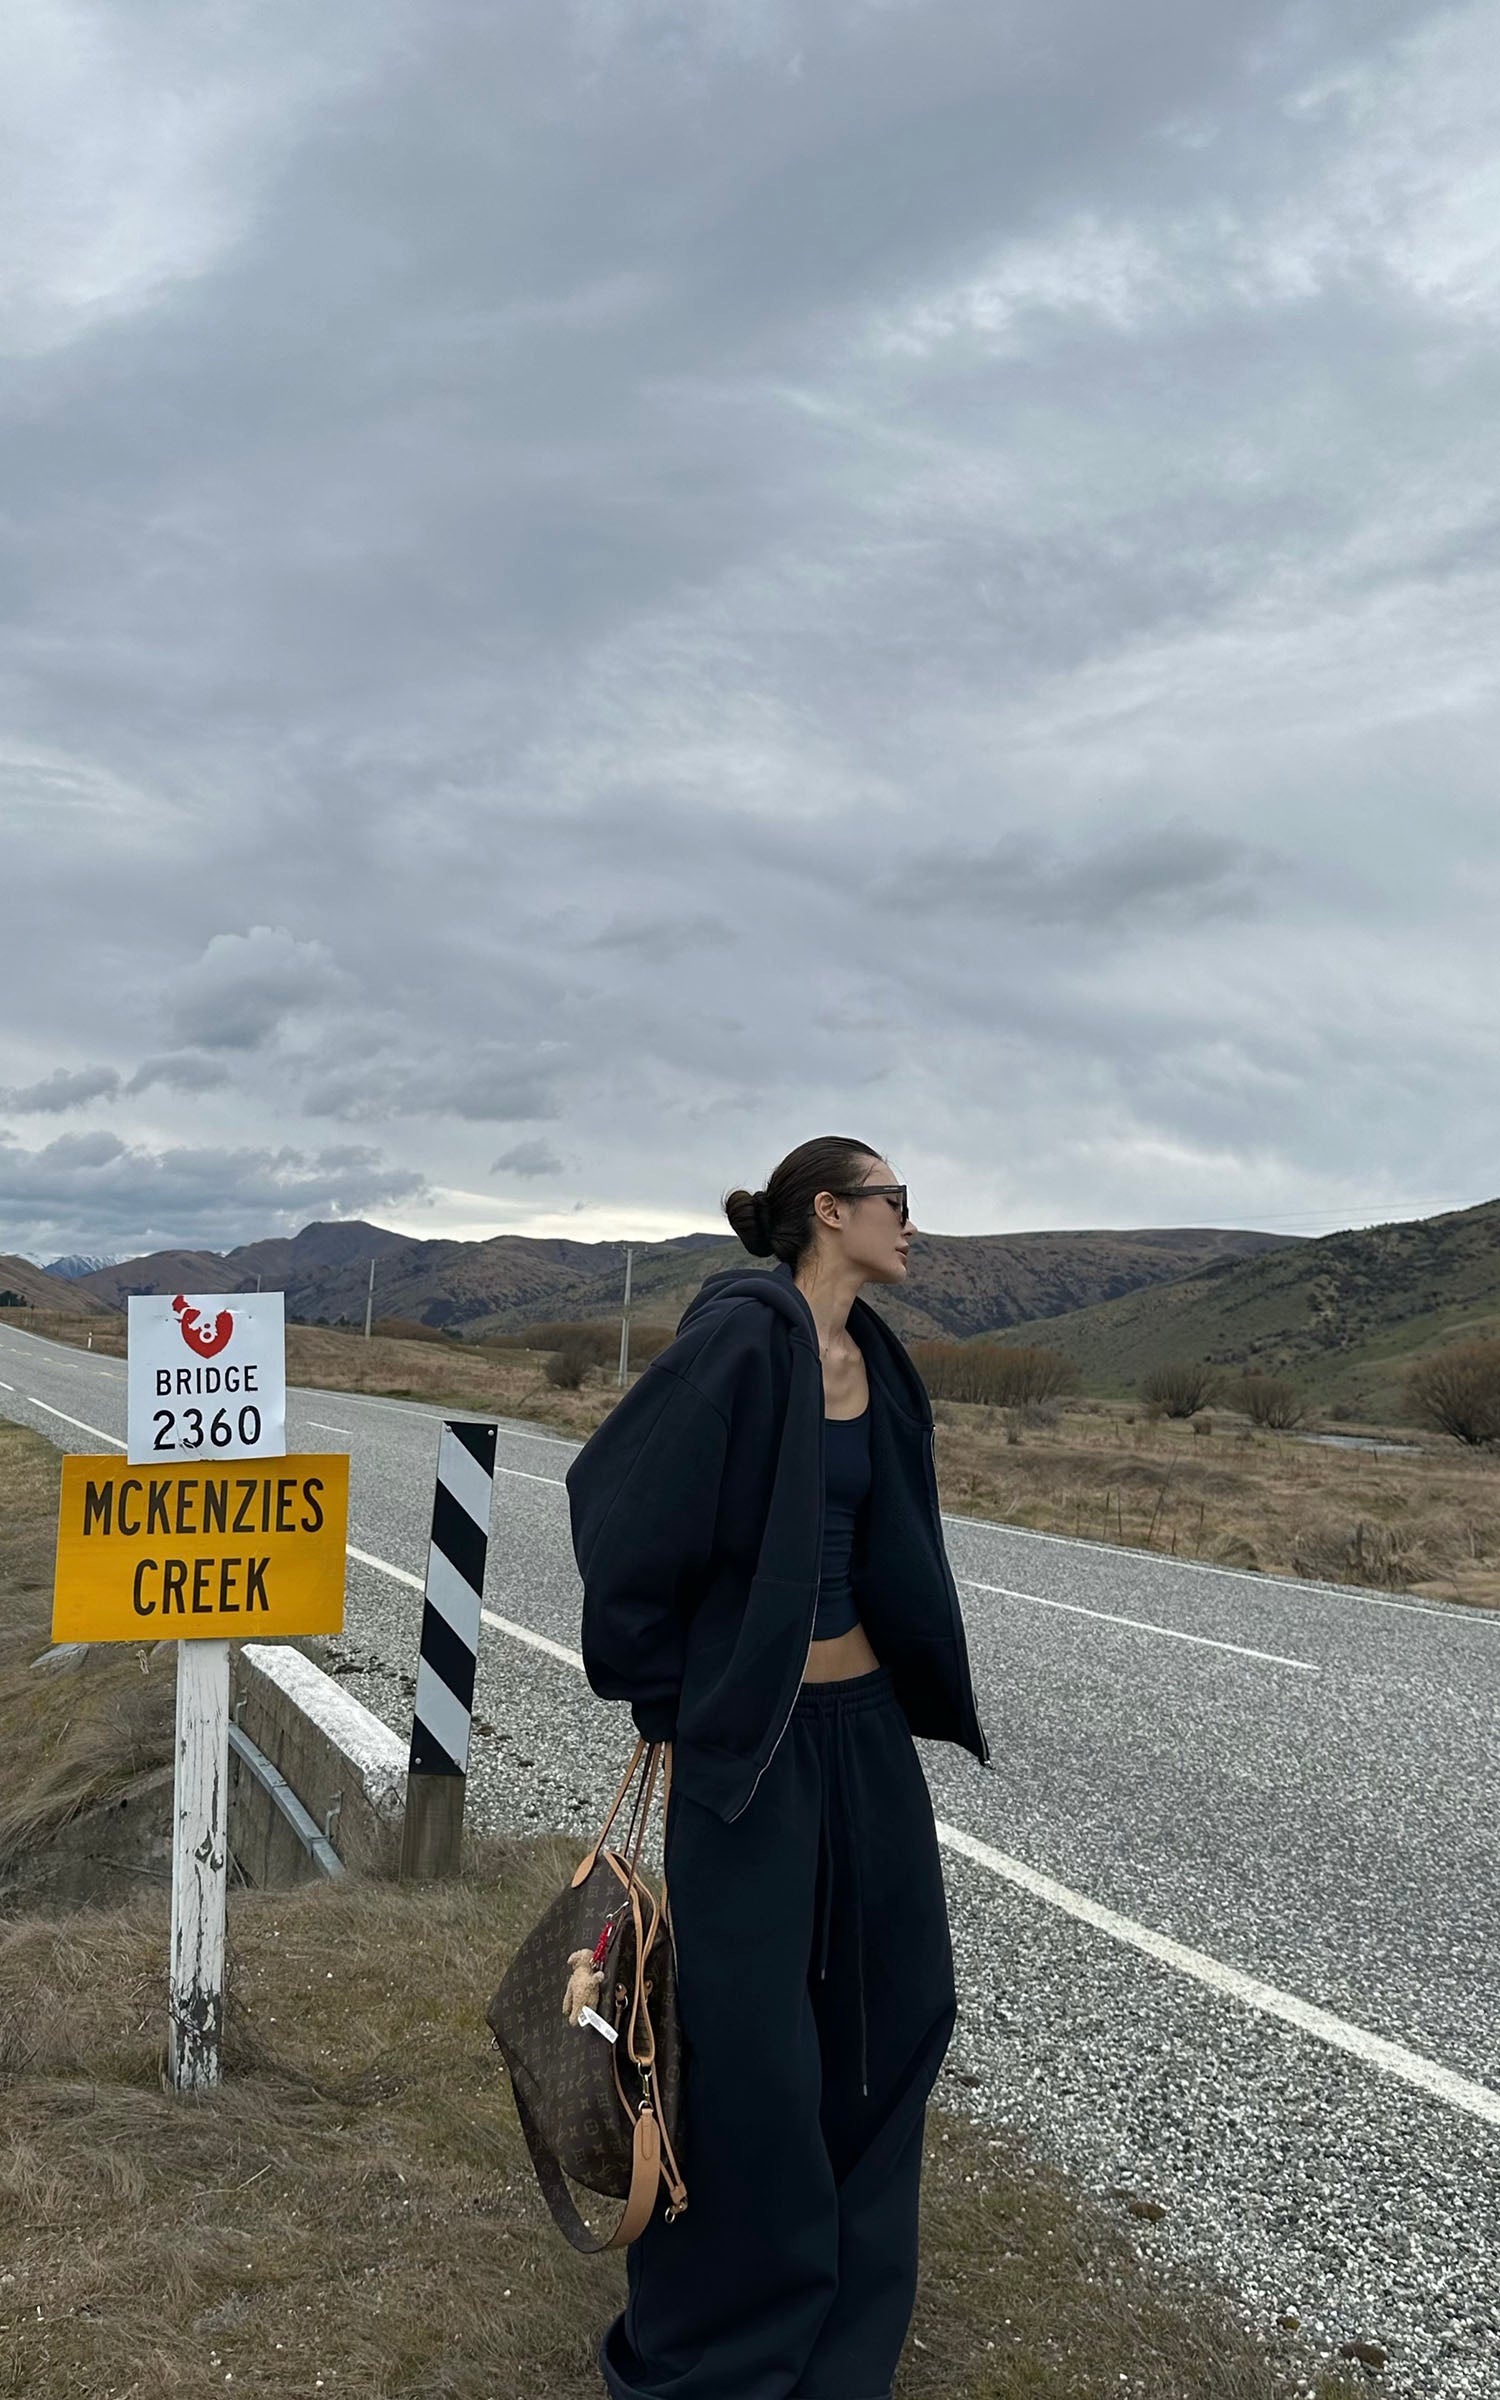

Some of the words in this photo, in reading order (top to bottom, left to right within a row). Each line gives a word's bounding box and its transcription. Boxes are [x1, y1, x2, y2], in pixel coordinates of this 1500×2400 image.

[199, 1321, 216, 1344] 8
[156, 1365, 259, 1396] BRIDGE
[153, 1405, 261, 1451] 2360
[83, 1478, 324, 1536] MCKENZIES
[133, 1557, 271, 1617] CREEK
